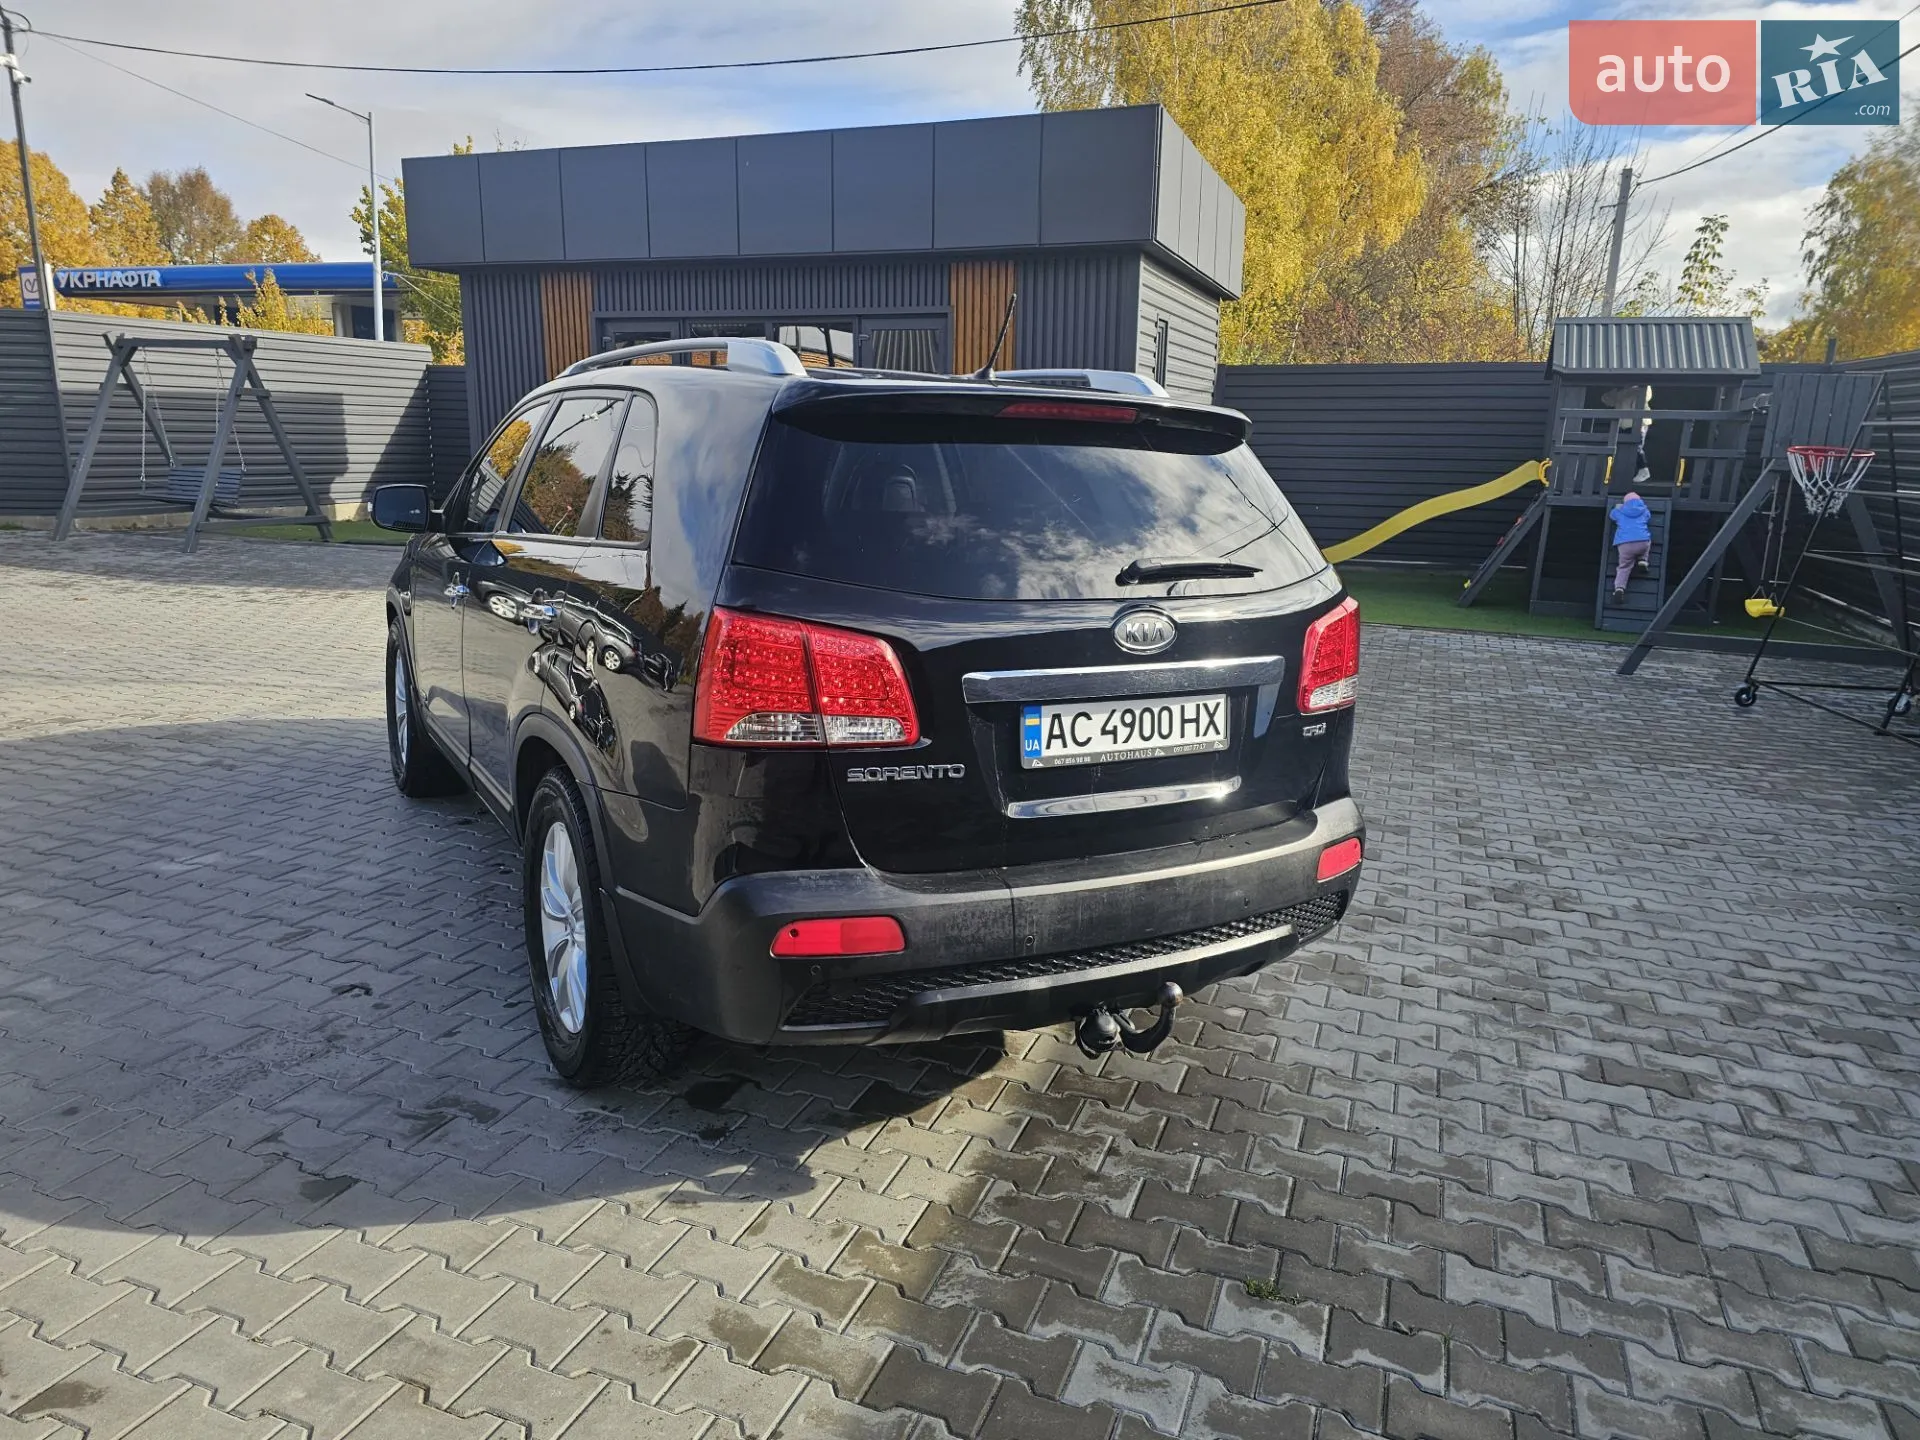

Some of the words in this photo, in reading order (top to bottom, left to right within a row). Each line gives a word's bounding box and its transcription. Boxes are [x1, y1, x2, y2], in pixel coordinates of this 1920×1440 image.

[56, 270, 161, 288] УКРНАФТА
[1125, 622, 1167, 643] KIA
[1045, 711, 1093, 750] AC
[1100, 705, 1174, 745] 4900
[1180, 701, 1222, 739] HX
[1025, 739, 1040, 752] UA
[1100, 748, 1152, 762] AUTOHAUS
[847, 763, 966, 783] SORENTO
